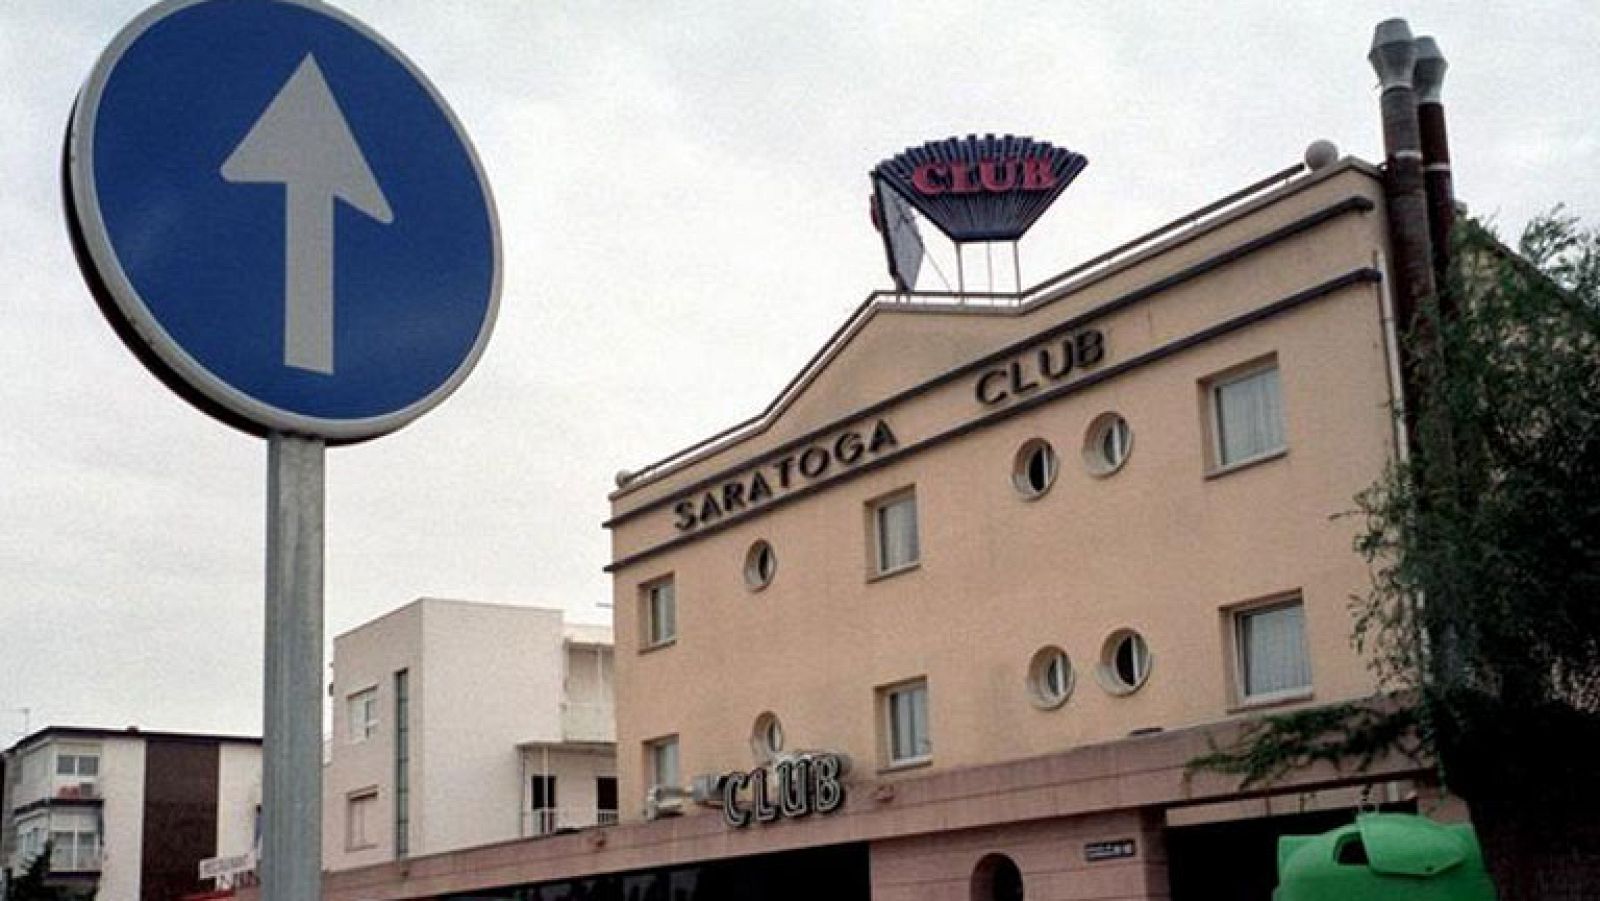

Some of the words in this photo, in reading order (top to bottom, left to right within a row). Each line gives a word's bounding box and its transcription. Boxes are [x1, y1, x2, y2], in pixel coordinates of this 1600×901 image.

[911, 155, 1057, 195] CLUB
[674, 419, 899, 531] SARATOGA
[975, 329, 1106, 406] CLUB
[723, 756, 843, 828] CLUB
